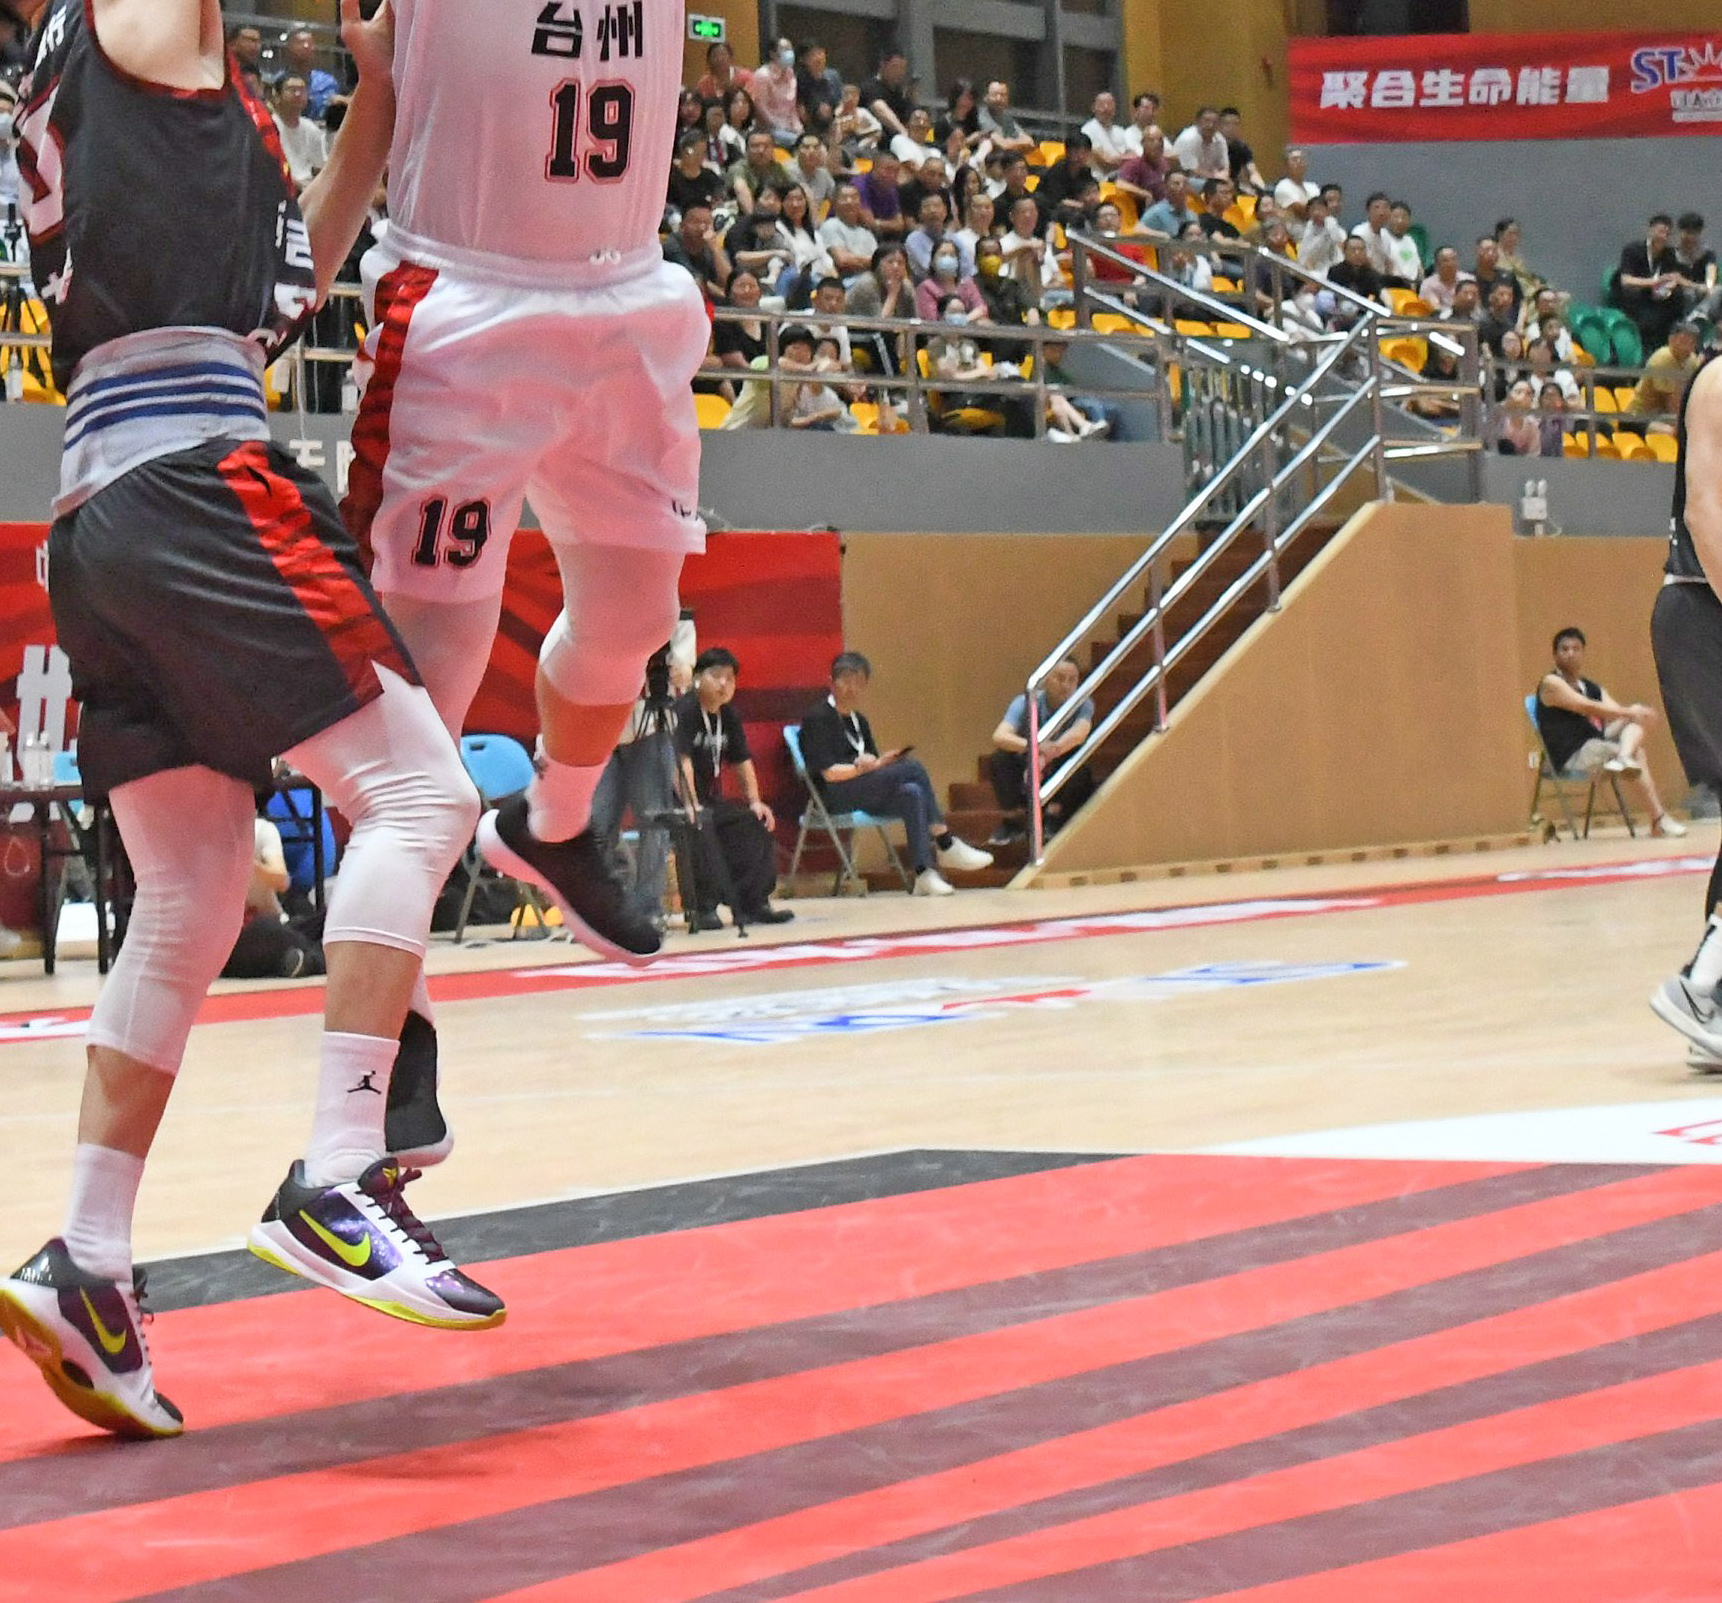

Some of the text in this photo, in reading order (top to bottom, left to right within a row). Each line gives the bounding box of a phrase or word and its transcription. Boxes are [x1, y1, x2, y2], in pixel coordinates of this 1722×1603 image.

[531, 0, 644, 62] 台州
[1319, 64, 1610, 110] 聚合生命能量
[544, 77, 636, 184] 19
[411, 494, 492, 570] 19
